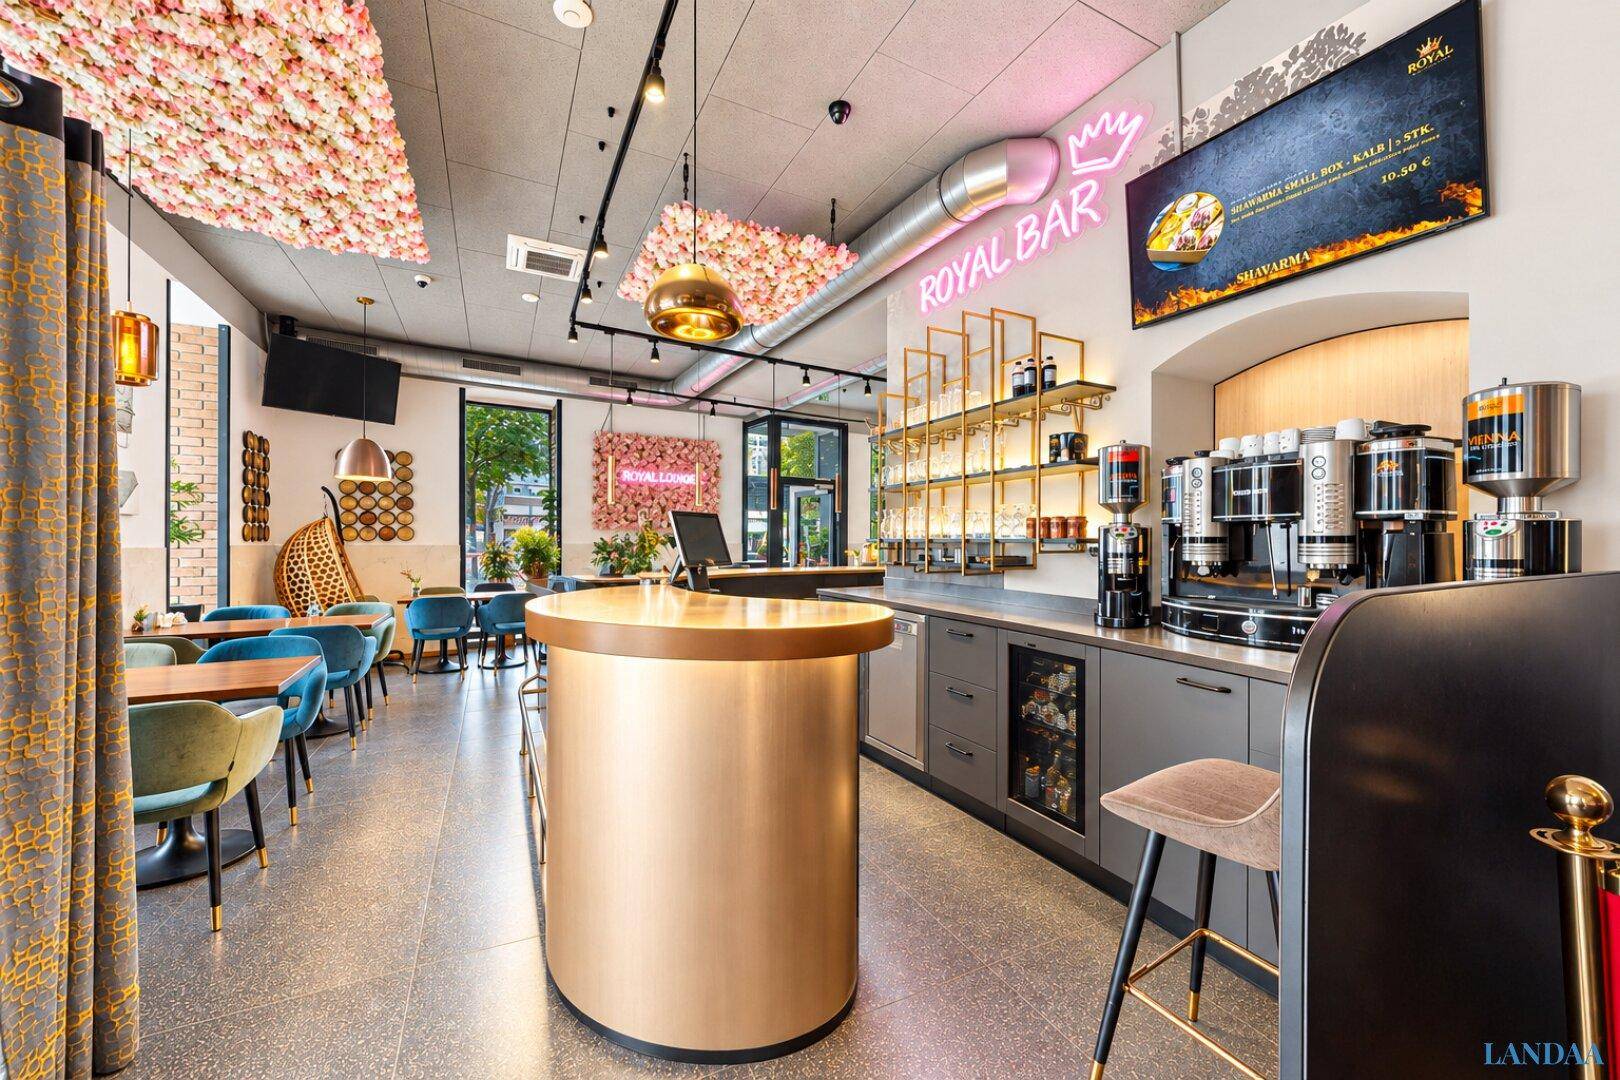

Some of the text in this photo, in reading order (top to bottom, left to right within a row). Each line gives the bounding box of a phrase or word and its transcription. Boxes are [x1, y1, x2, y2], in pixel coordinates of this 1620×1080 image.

[1408, 45, 1454, 75] ROYAL
[1231, 187, 1283, 216] SHAWARMA
[1284, 172, 1318, 193] SMALL
[1320, 160, 1344, 178] BOX
[1352, 142, 1385, 163] KALB
[1403, 123, 1435, 142] STK.
[1381, 162, 1418, 184] 10.50
[1421, 156, 1431, 167] €
[919, 178, 1101, 313] ROYAL BAR
[1236, 250, 1311, 284] SHAVARMA
[1468, 430, 1520, 446] VIENNA
[622, 469, 697, 485] ROYAL LOUNGE
